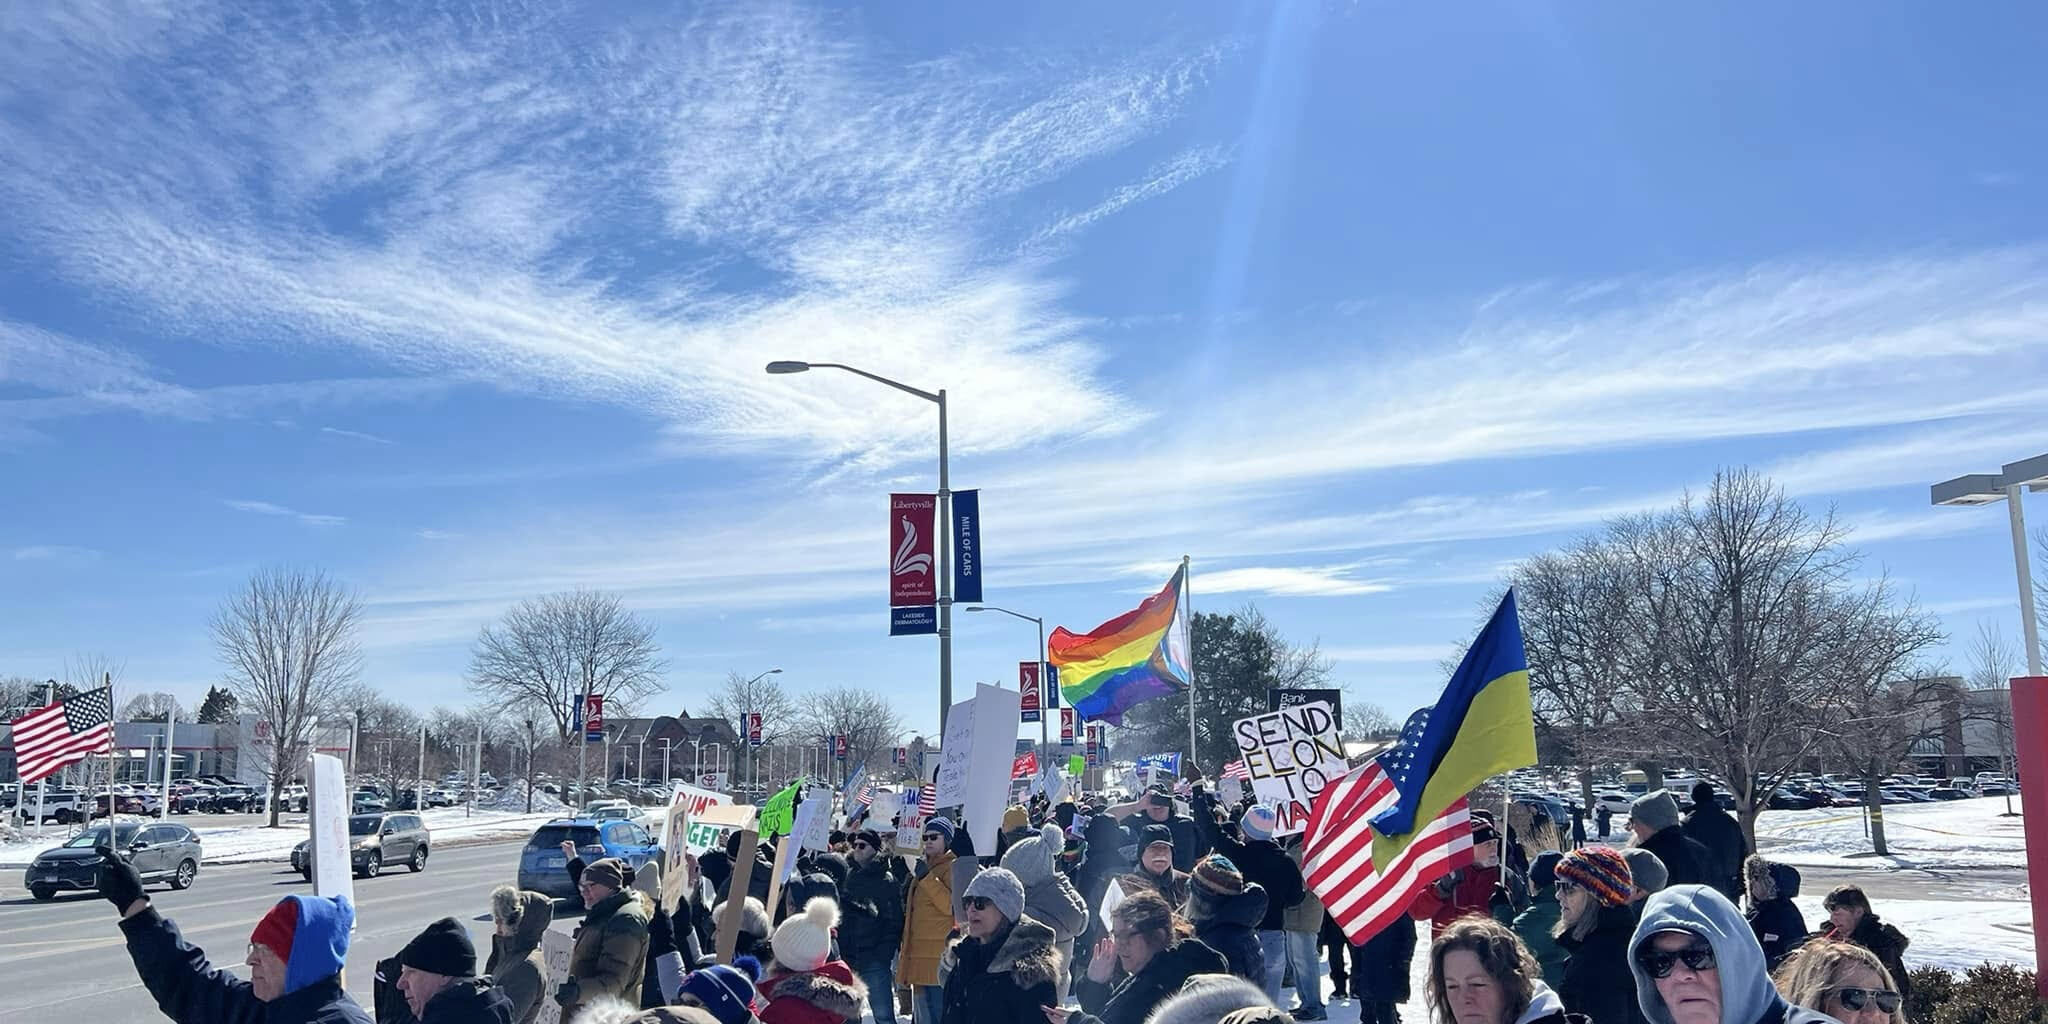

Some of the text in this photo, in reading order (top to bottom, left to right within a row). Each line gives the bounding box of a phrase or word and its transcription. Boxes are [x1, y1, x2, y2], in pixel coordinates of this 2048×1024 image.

[894, 500, 934, 511] Libertyville
[961, 516, 972, 576] MILE OF CARS
[895, 590, 932, 598] independence
[901, 582, 917, 590] spirit
[1280, 693, 1306, 703] Bank
[1237, 707, 1332, 752] SEND
[1245, 732, 1346, 780] ELON
[1279, 767, 1329, 799] TO
